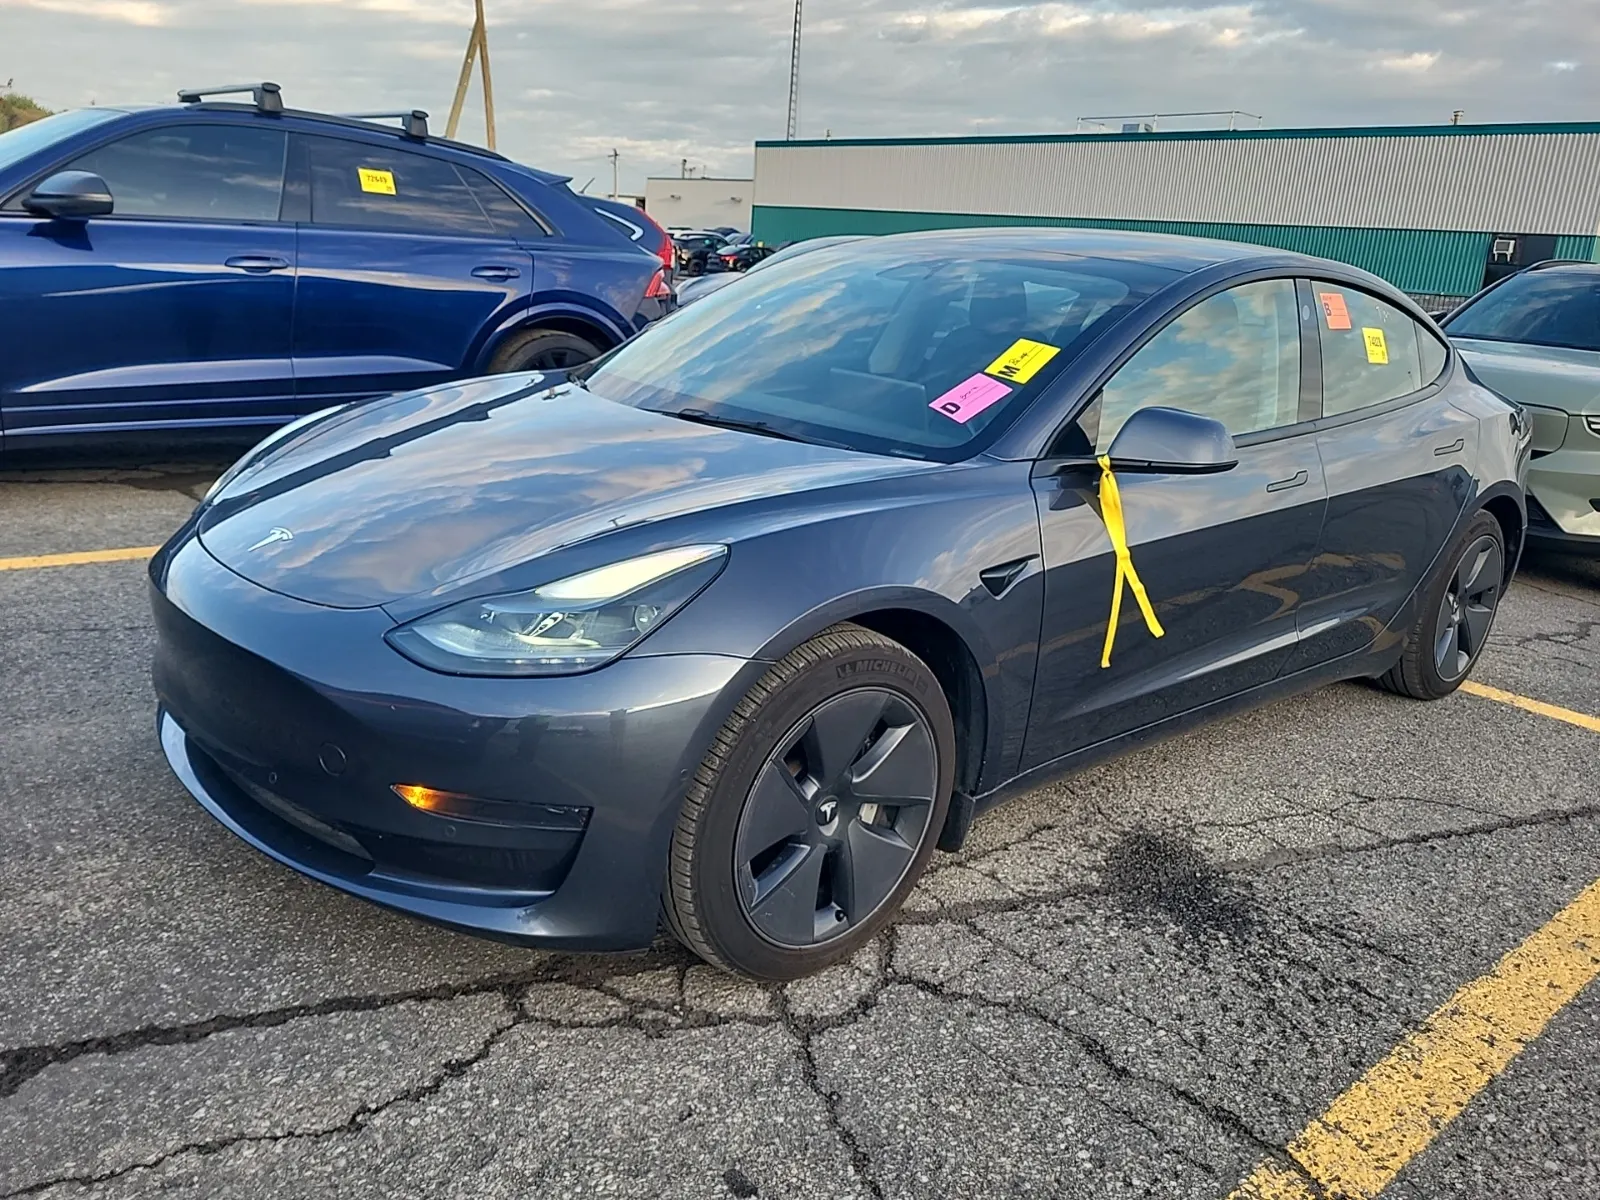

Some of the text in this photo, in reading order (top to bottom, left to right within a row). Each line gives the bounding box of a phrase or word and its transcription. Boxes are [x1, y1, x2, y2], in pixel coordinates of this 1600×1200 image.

[1323, 302, 1332, 317] B
[997, 364, 1021, 378] M
[939, 401, 961, 415] D
[855, 659, 917, 685] MICHELIN
